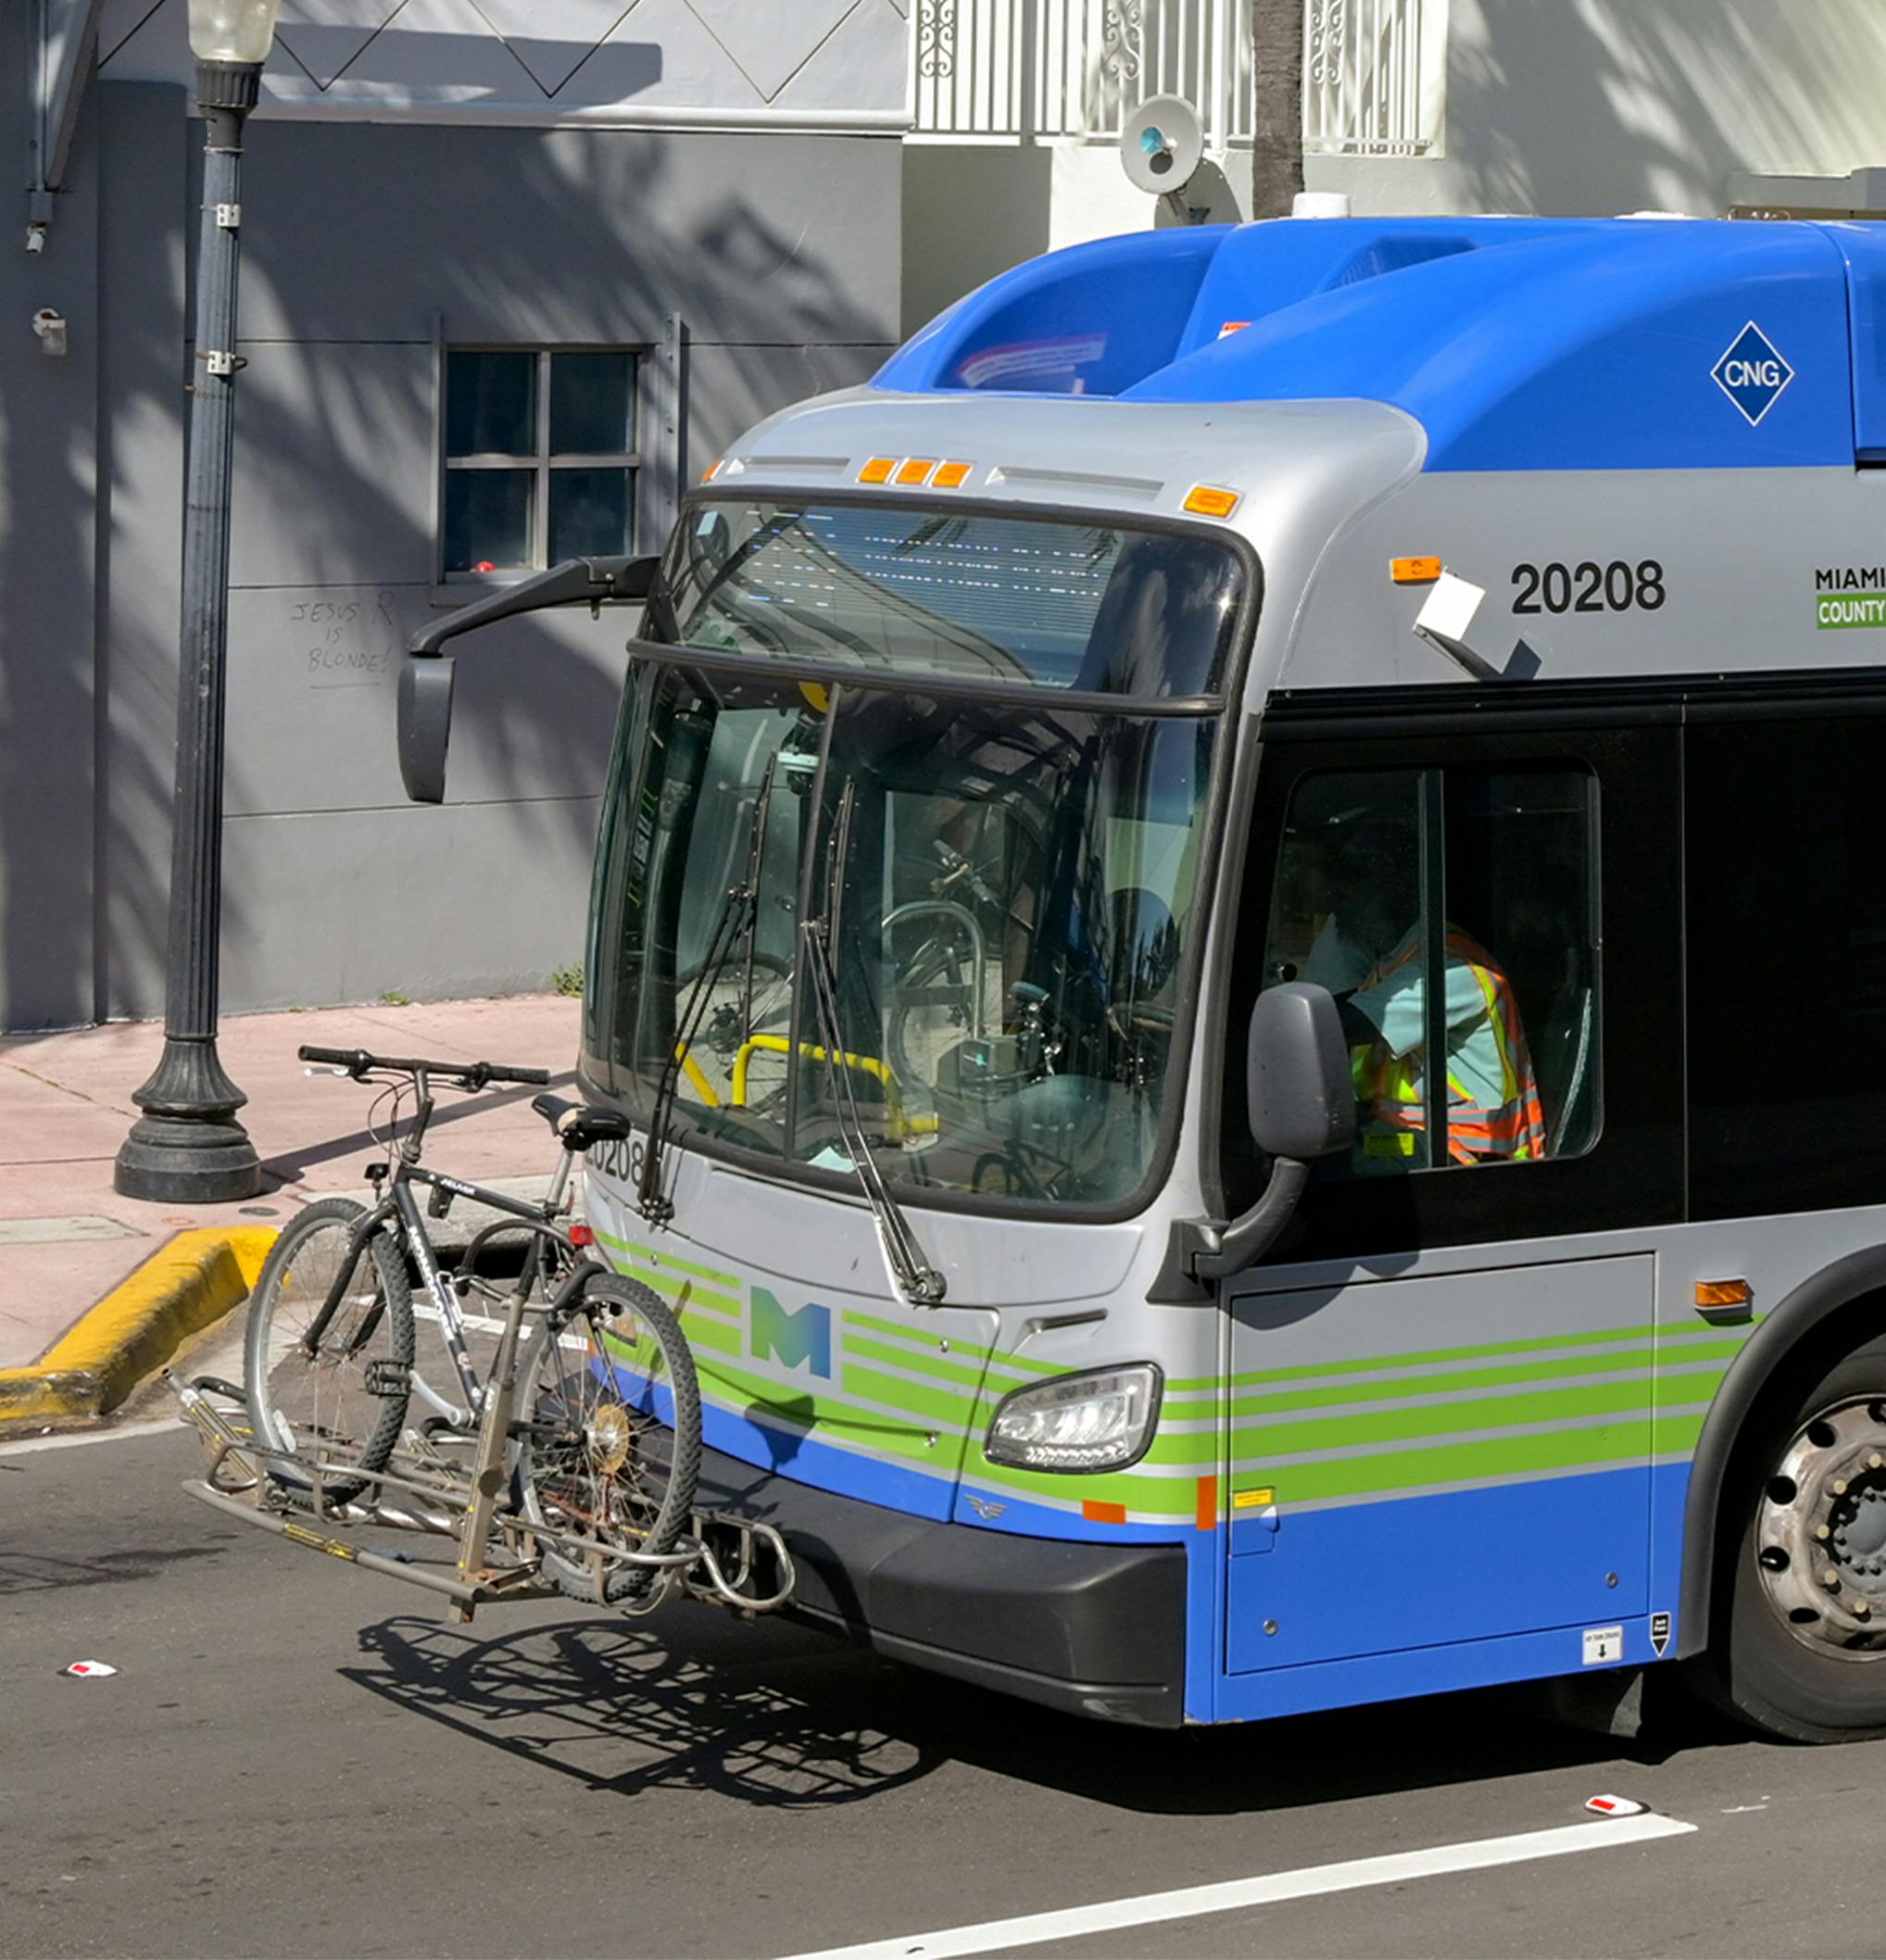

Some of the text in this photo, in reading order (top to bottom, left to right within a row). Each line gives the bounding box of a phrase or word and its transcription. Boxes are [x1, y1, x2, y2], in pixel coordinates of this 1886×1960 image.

[1724, 359, 1779, 387] CNG
[1511, 559, 1666, 614] 20208
[1816, 566, 1886, 590] MIAMI
[291, 602, 360, 623] JESUS
[1818, 599, 1886, 623] COUNTY
[325, 627, 344, 644] IS
[585, 1139, 645, 1187] 0208
[749, 1285, 831, 1380] M
